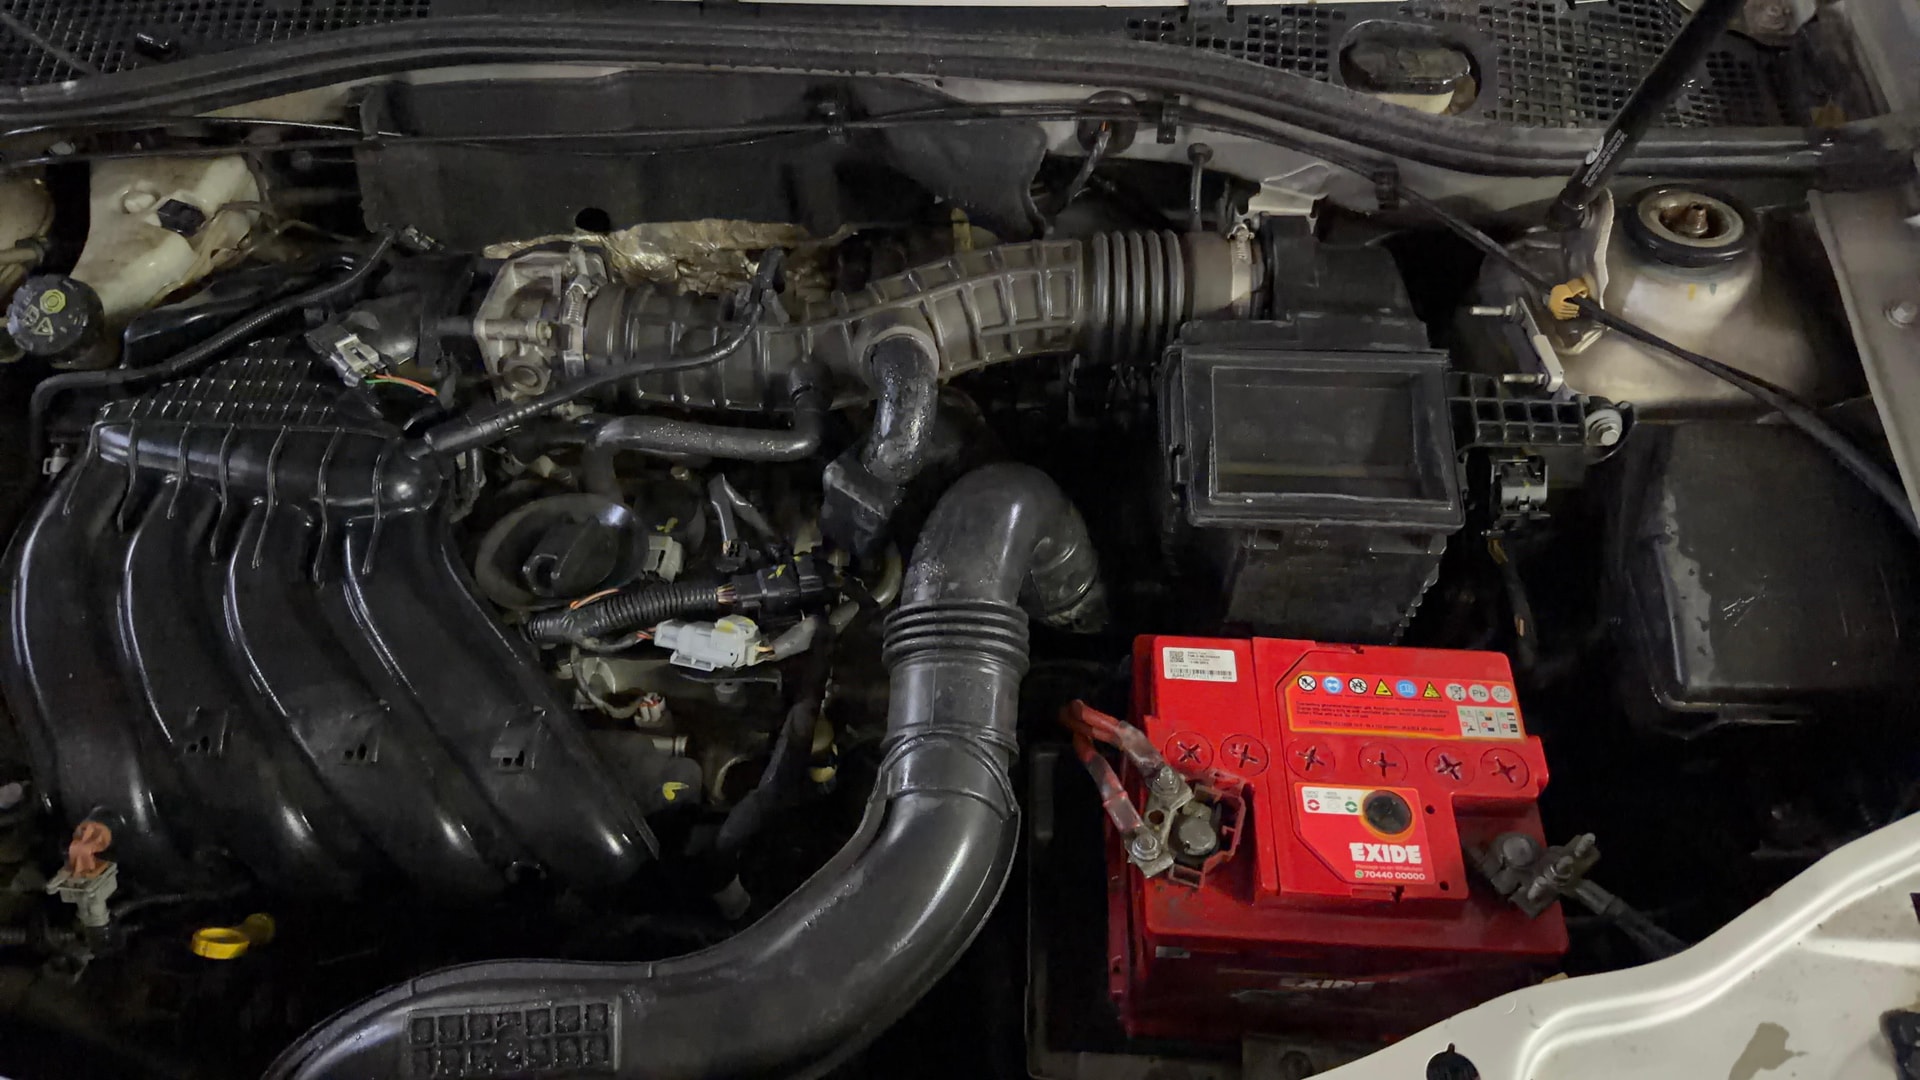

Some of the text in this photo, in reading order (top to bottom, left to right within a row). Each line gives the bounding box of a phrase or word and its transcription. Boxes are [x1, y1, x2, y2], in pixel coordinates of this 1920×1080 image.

[1472, 689, 1487, 698] Pb
[1348, 842, 1422, 864] EXIDE
[1364, 870, 1425, 880] 70440 00000
